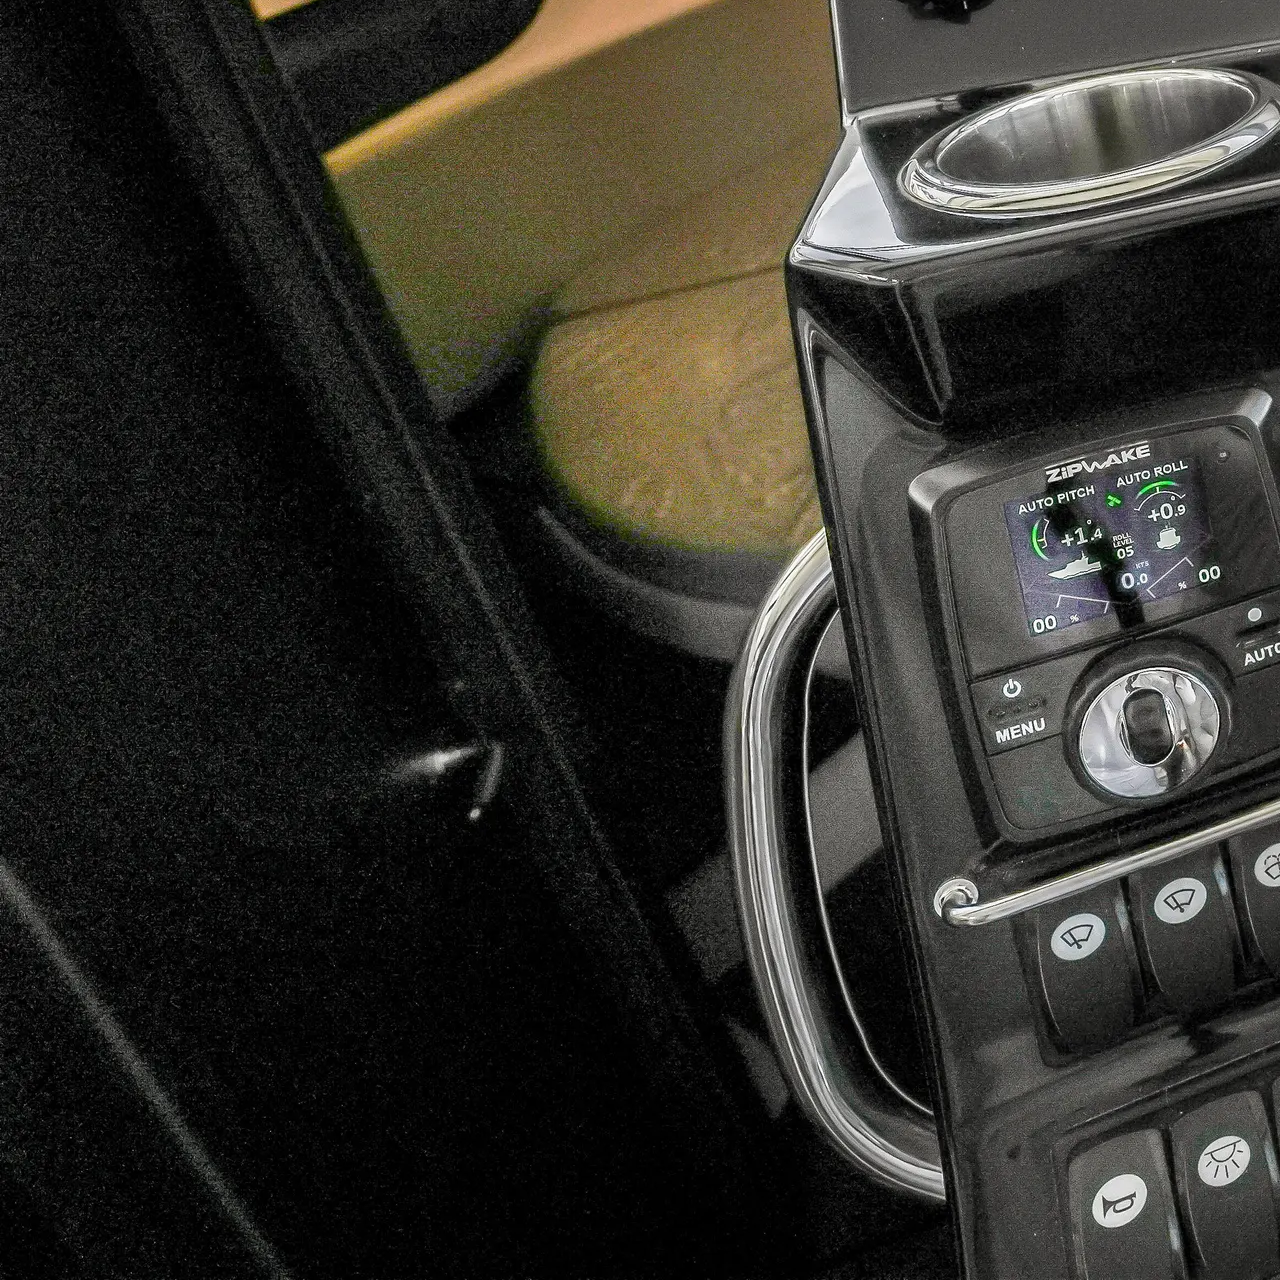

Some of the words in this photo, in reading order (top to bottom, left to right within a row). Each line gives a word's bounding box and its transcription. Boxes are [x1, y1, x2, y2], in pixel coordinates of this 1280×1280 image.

[1116, 471, 1150, 489] AUTO
[1153, 460, 1189, 479] ROLL
[1018, 497, 1053, 516] AUTO
[1057, 485, 1096, 504] PITCH
[1113, 532, 1132, 543] ROLL
[1113, 538, 1135, 549] LEVEL
[1116, 546, 1135, 561] 05
[1121, 572, 1149, 590] 0.0
[1198, 566, 1221, 584] 00
[1032, 615, 1058, 634] 00
[995, 717, 1047, 744] MENU
